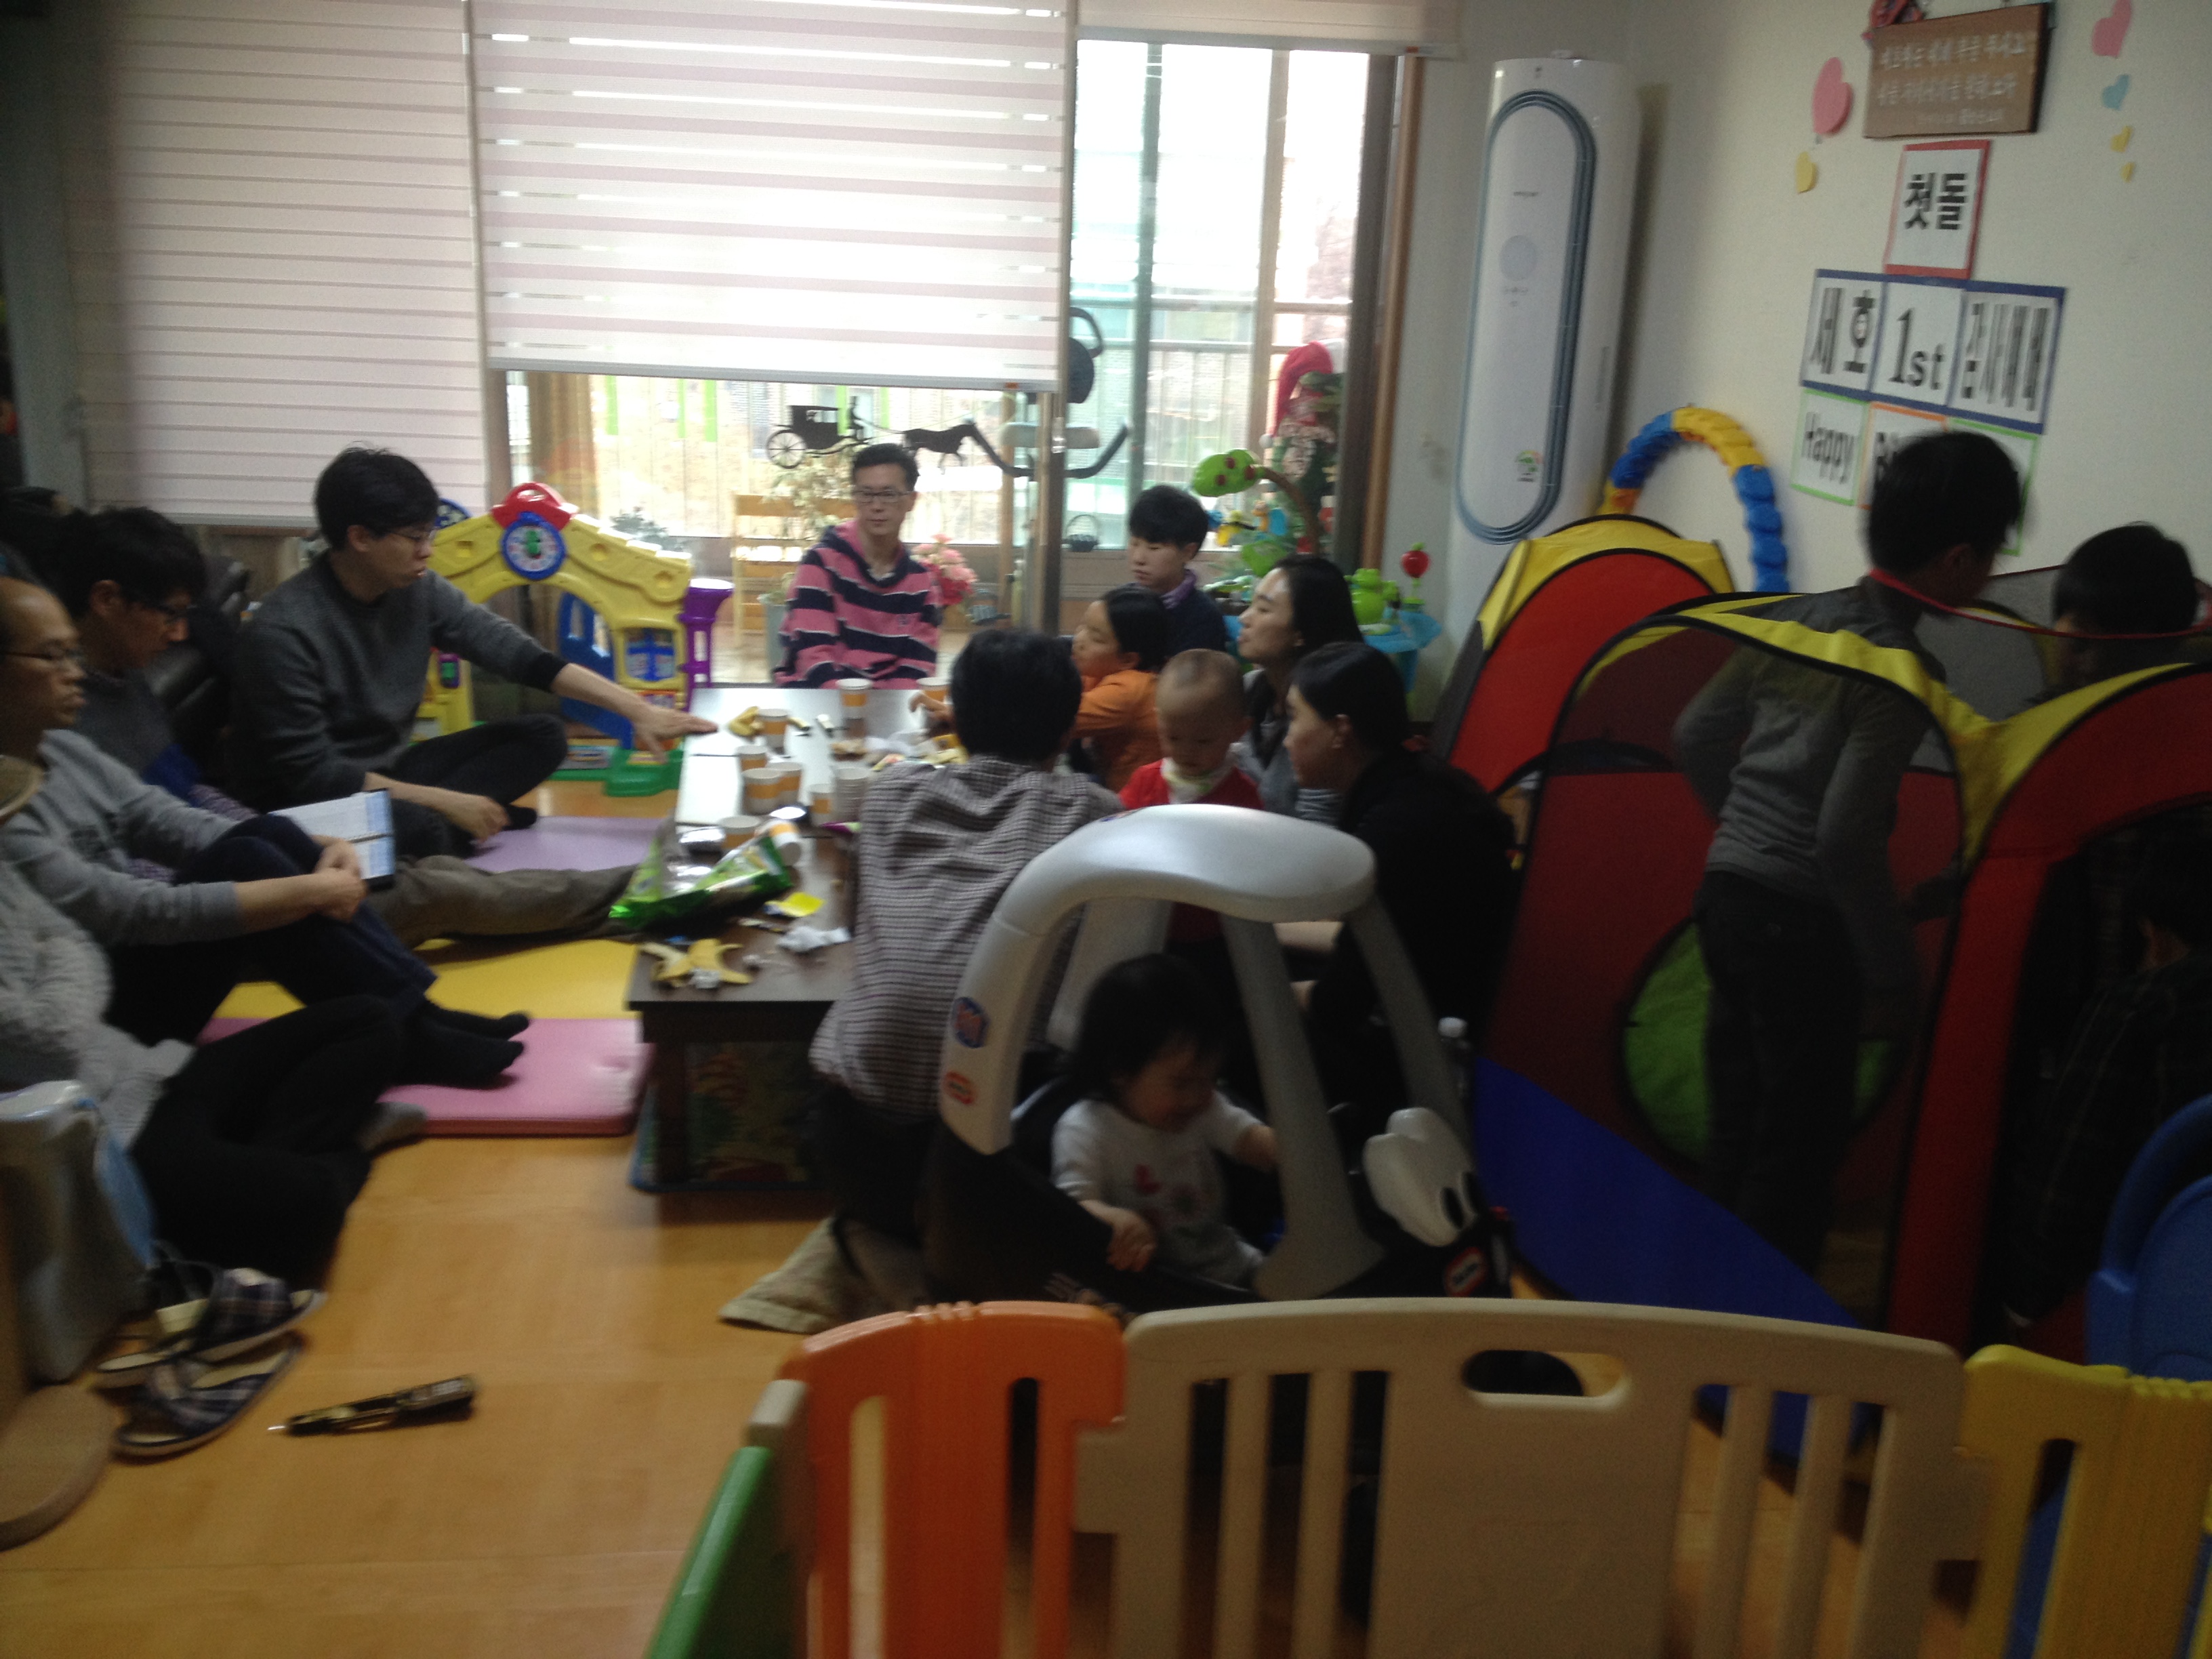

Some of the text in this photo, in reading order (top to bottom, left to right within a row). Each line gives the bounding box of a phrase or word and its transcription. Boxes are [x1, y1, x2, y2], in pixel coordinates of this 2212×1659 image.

[1904, 172, 1967, 230] 첫돌
[1810, 287, 1875, 375] 세호
[1889, 308, 1946, 390] 1st
[1801, 411, 1855, 484] Happy
